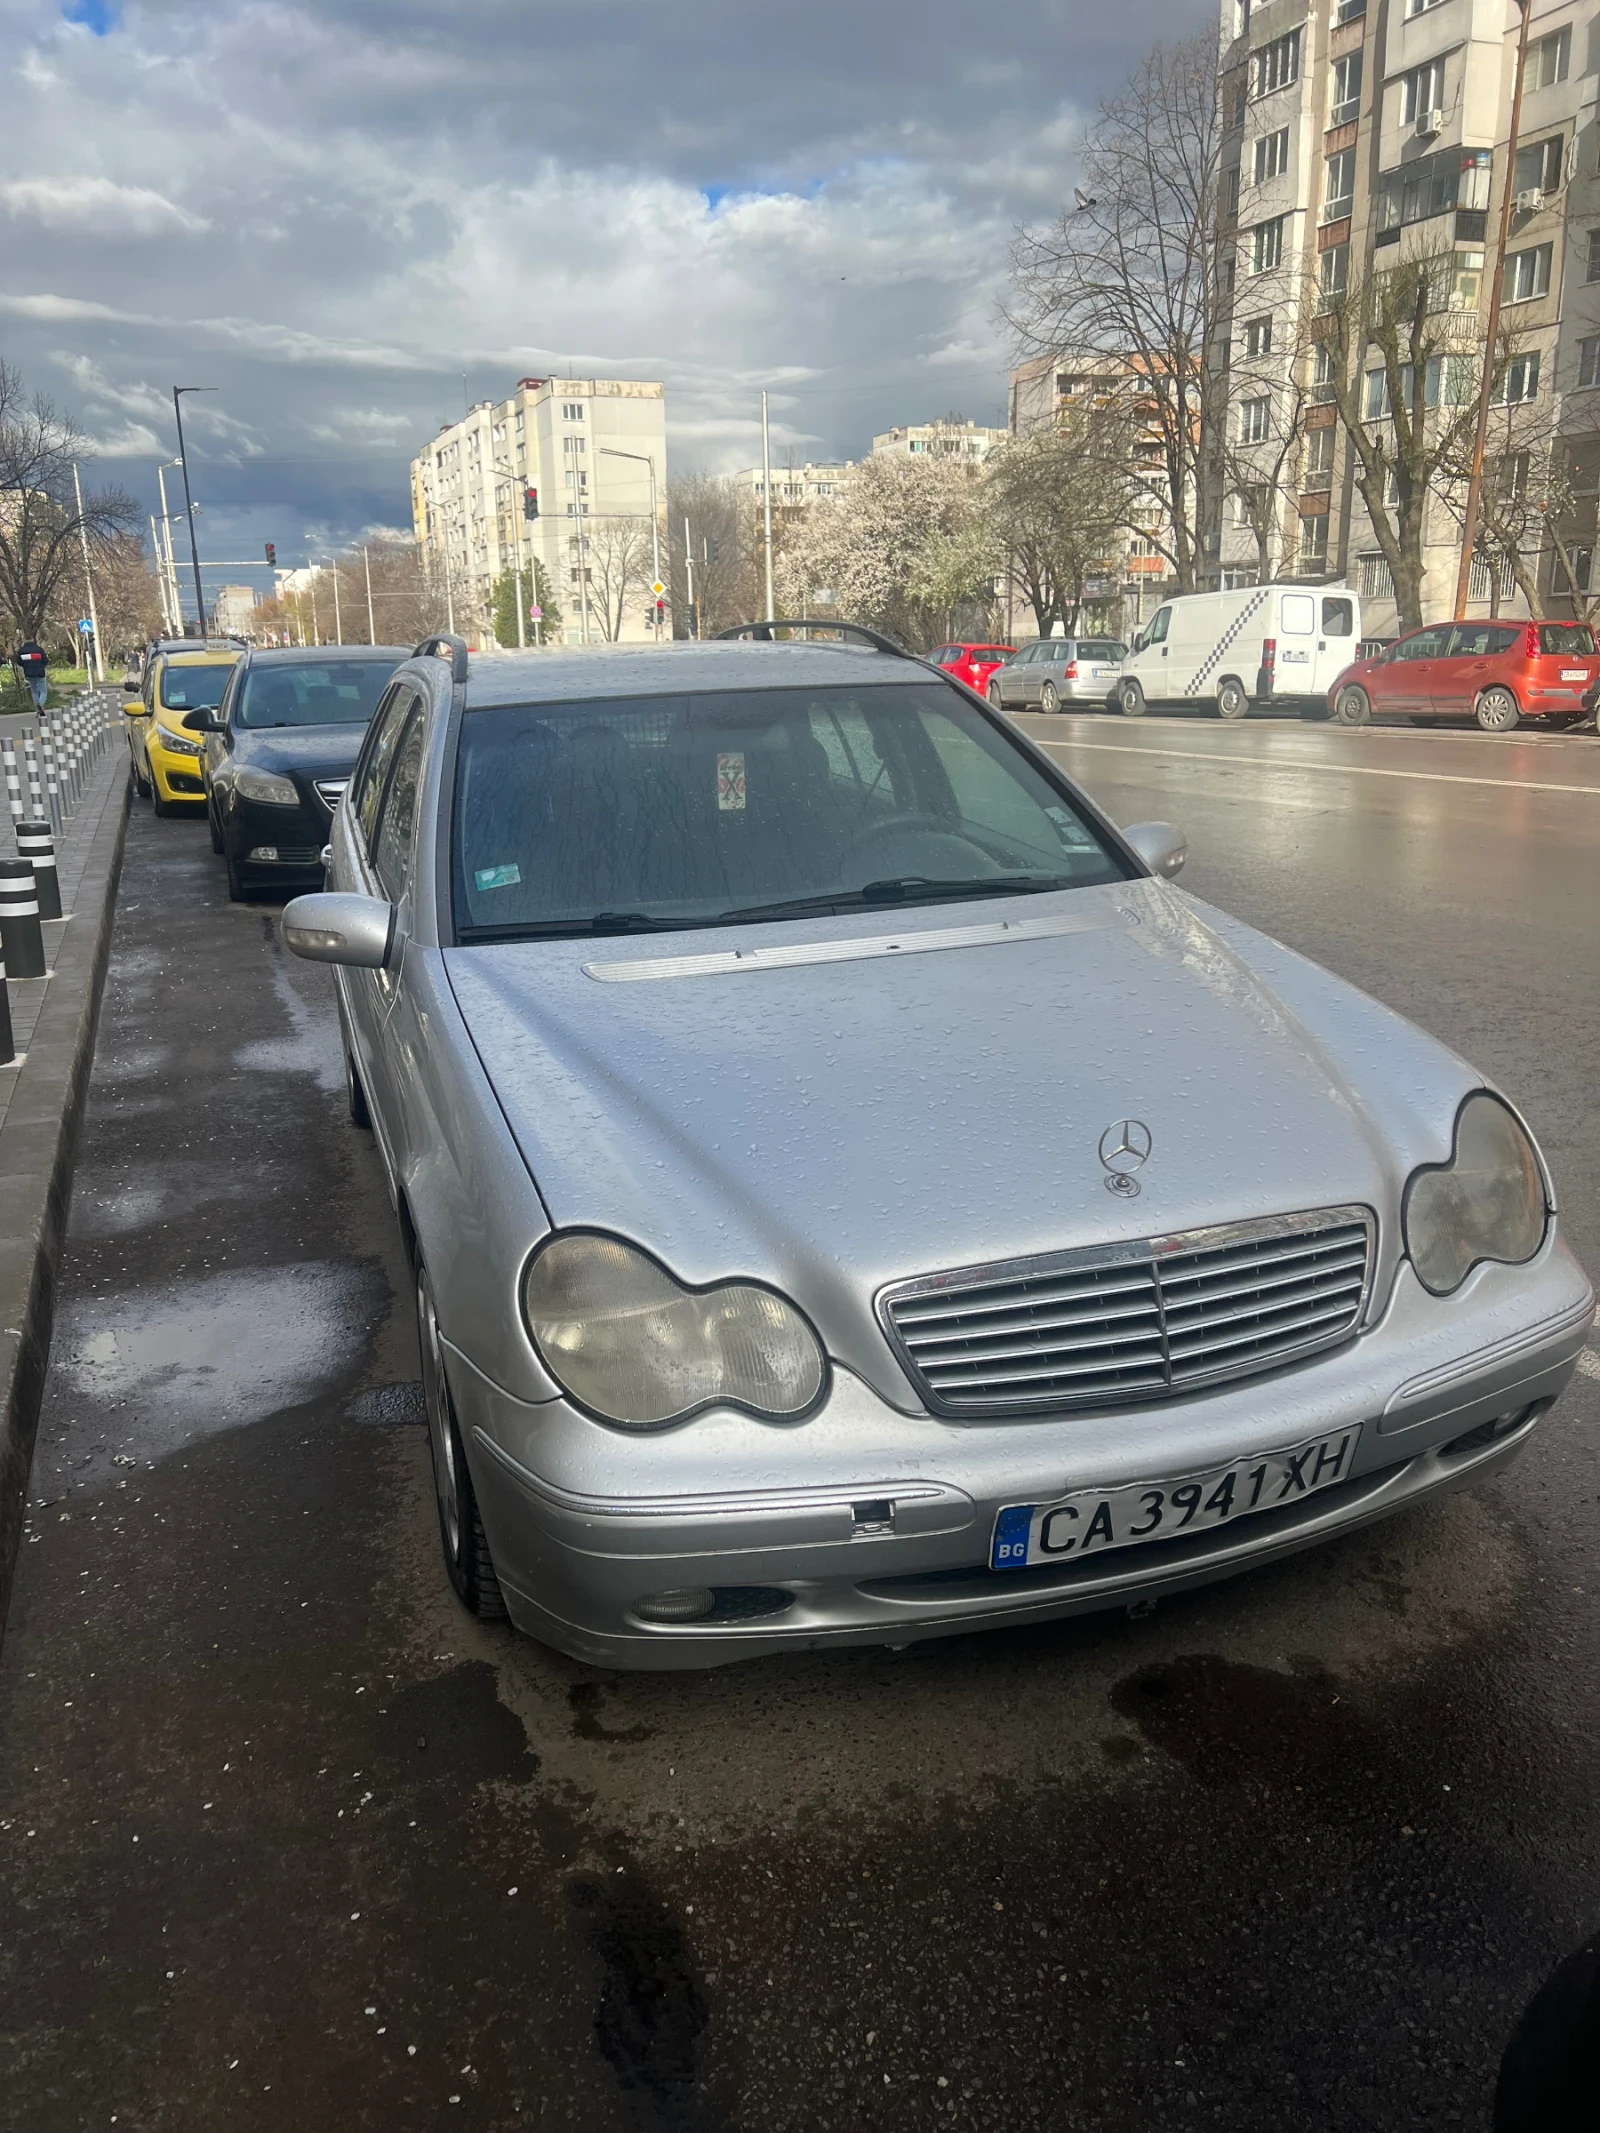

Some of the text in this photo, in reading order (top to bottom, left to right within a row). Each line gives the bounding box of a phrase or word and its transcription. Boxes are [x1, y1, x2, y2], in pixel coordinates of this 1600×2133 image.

[1039, 1433, 1351, 1554] CA 3941 XH
[998, 1542, 1025, 1559] BG
